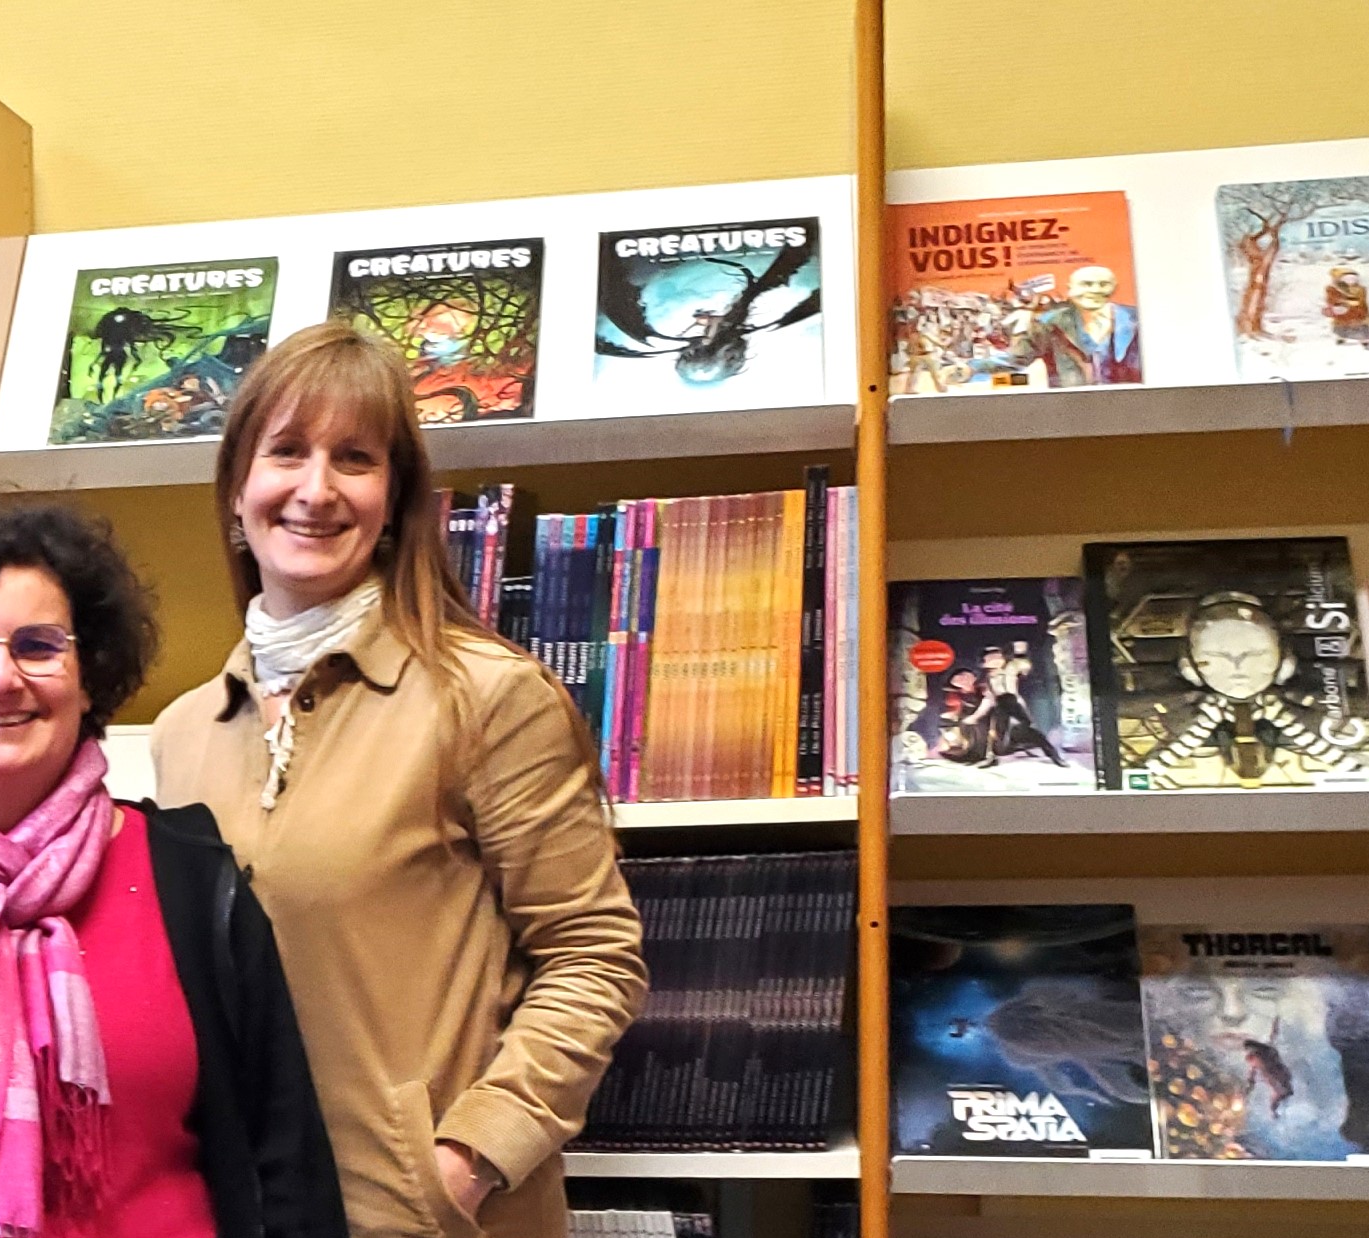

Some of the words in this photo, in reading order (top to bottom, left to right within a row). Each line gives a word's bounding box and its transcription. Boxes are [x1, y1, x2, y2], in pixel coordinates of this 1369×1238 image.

[615, 227, 807, 258] CREATURES
[909, 218, 1070, 248] INDIGNEZ-
[348, 247, 532, 277] CREATURES
[90, 268, 265, 296] CREATURES
